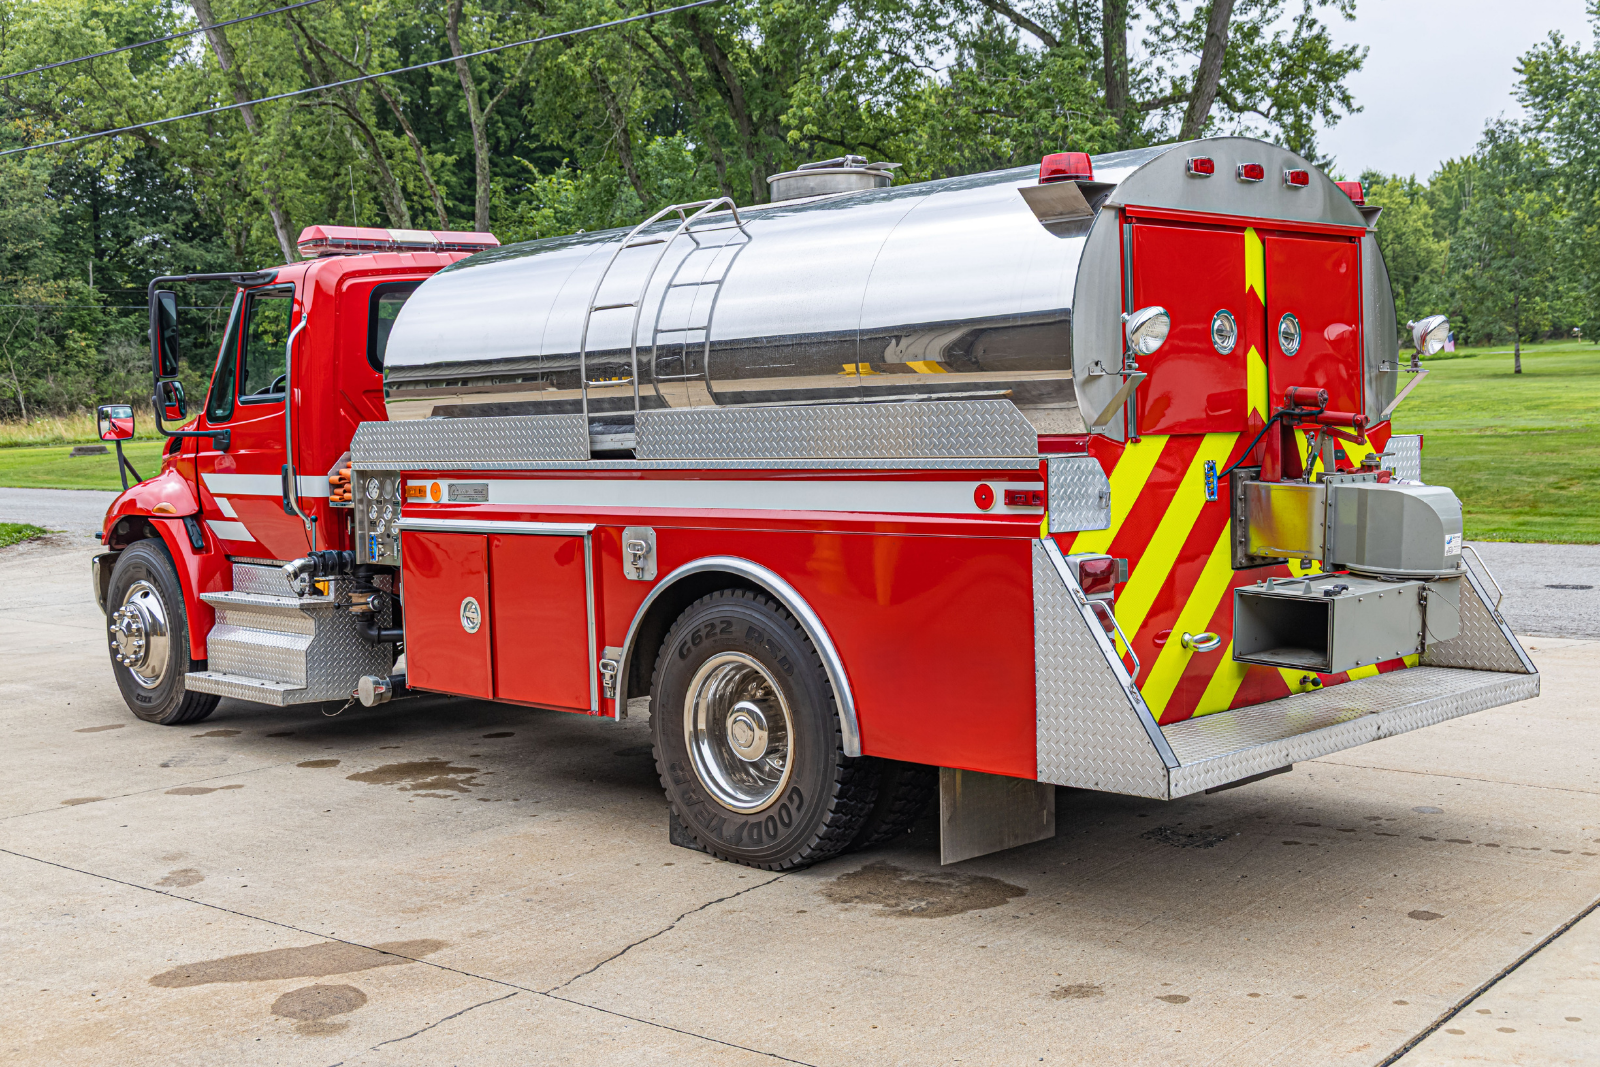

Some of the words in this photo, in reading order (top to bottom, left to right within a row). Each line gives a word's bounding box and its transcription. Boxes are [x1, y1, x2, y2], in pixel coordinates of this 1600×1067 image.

[678, 620, 733, 660] G622
[745, 626, 794, 676] RSD
[669, 761, 804, 846] GOODYEAR
